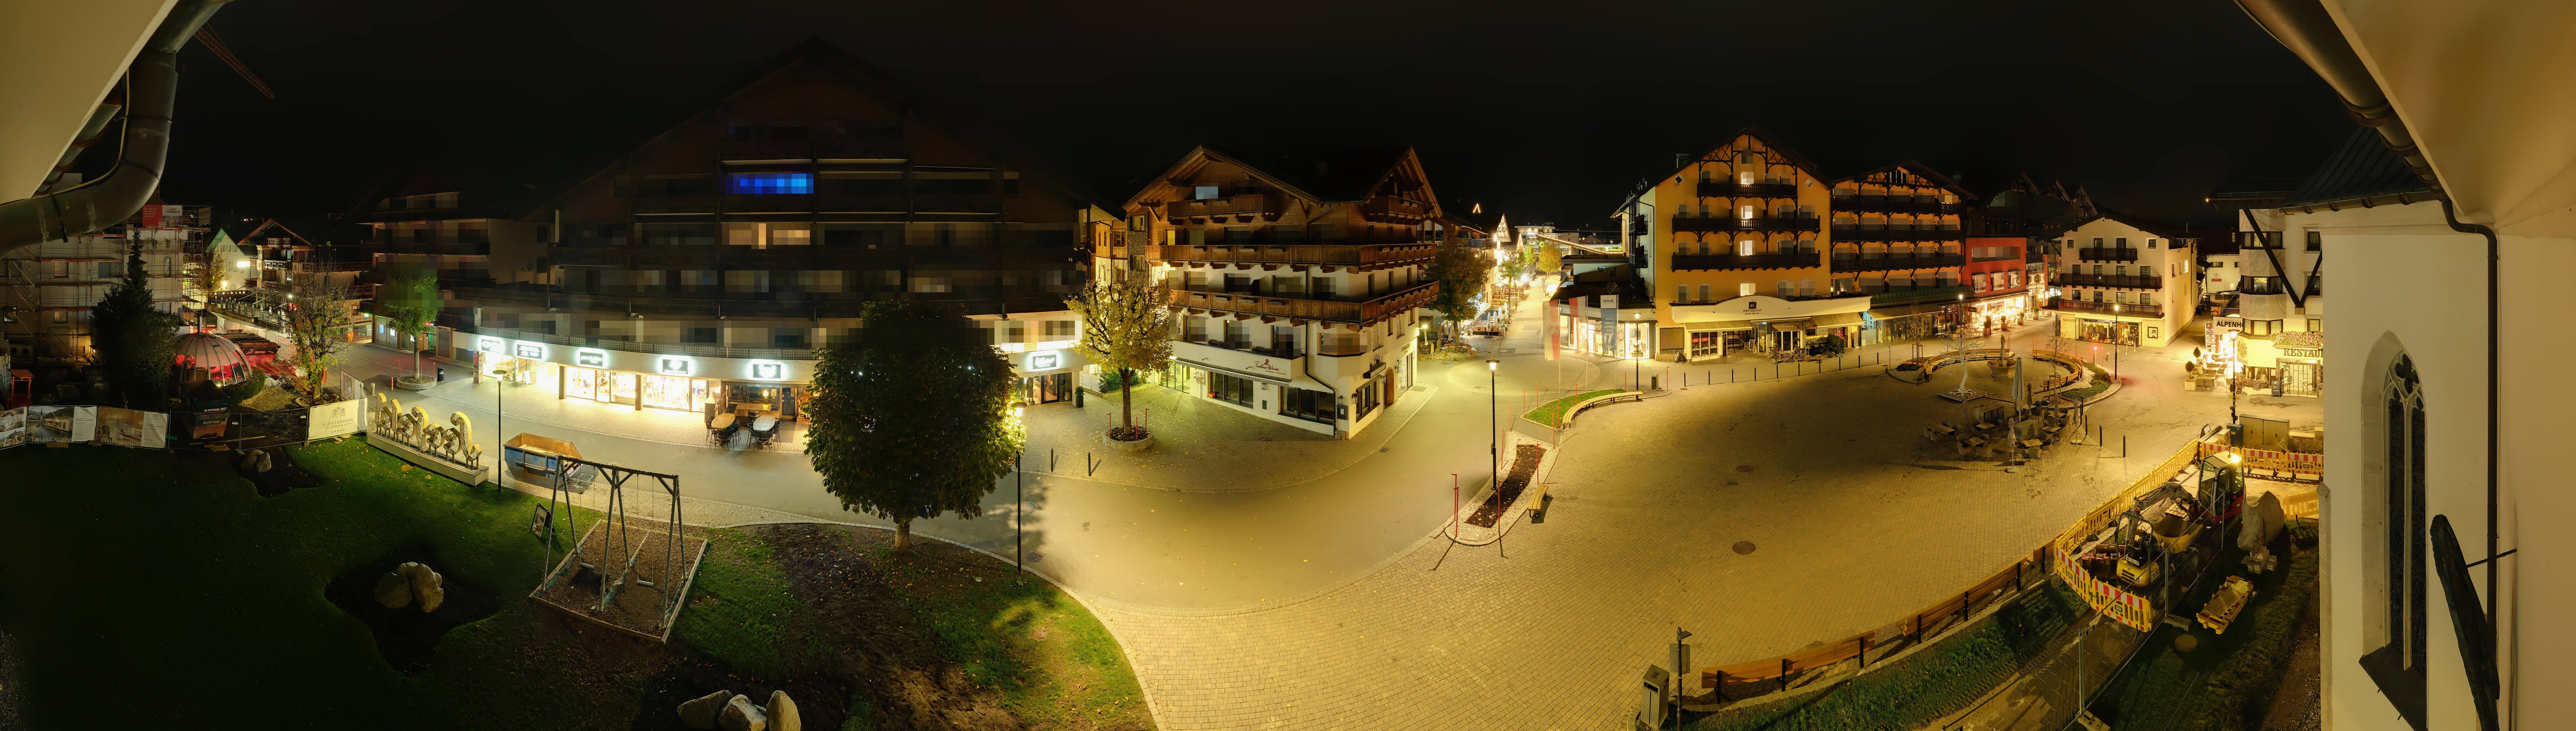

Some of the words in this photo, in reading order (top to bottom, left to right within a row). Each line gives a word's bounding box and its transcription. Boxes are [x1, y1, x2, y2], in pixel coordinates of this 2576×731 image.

[1371, 364, 1385, 377] RESTAURANT
[323, 418, 353, 426] KLOSTERBRÄU
[2157, 493, 2171, 502] TAKEUCHI
